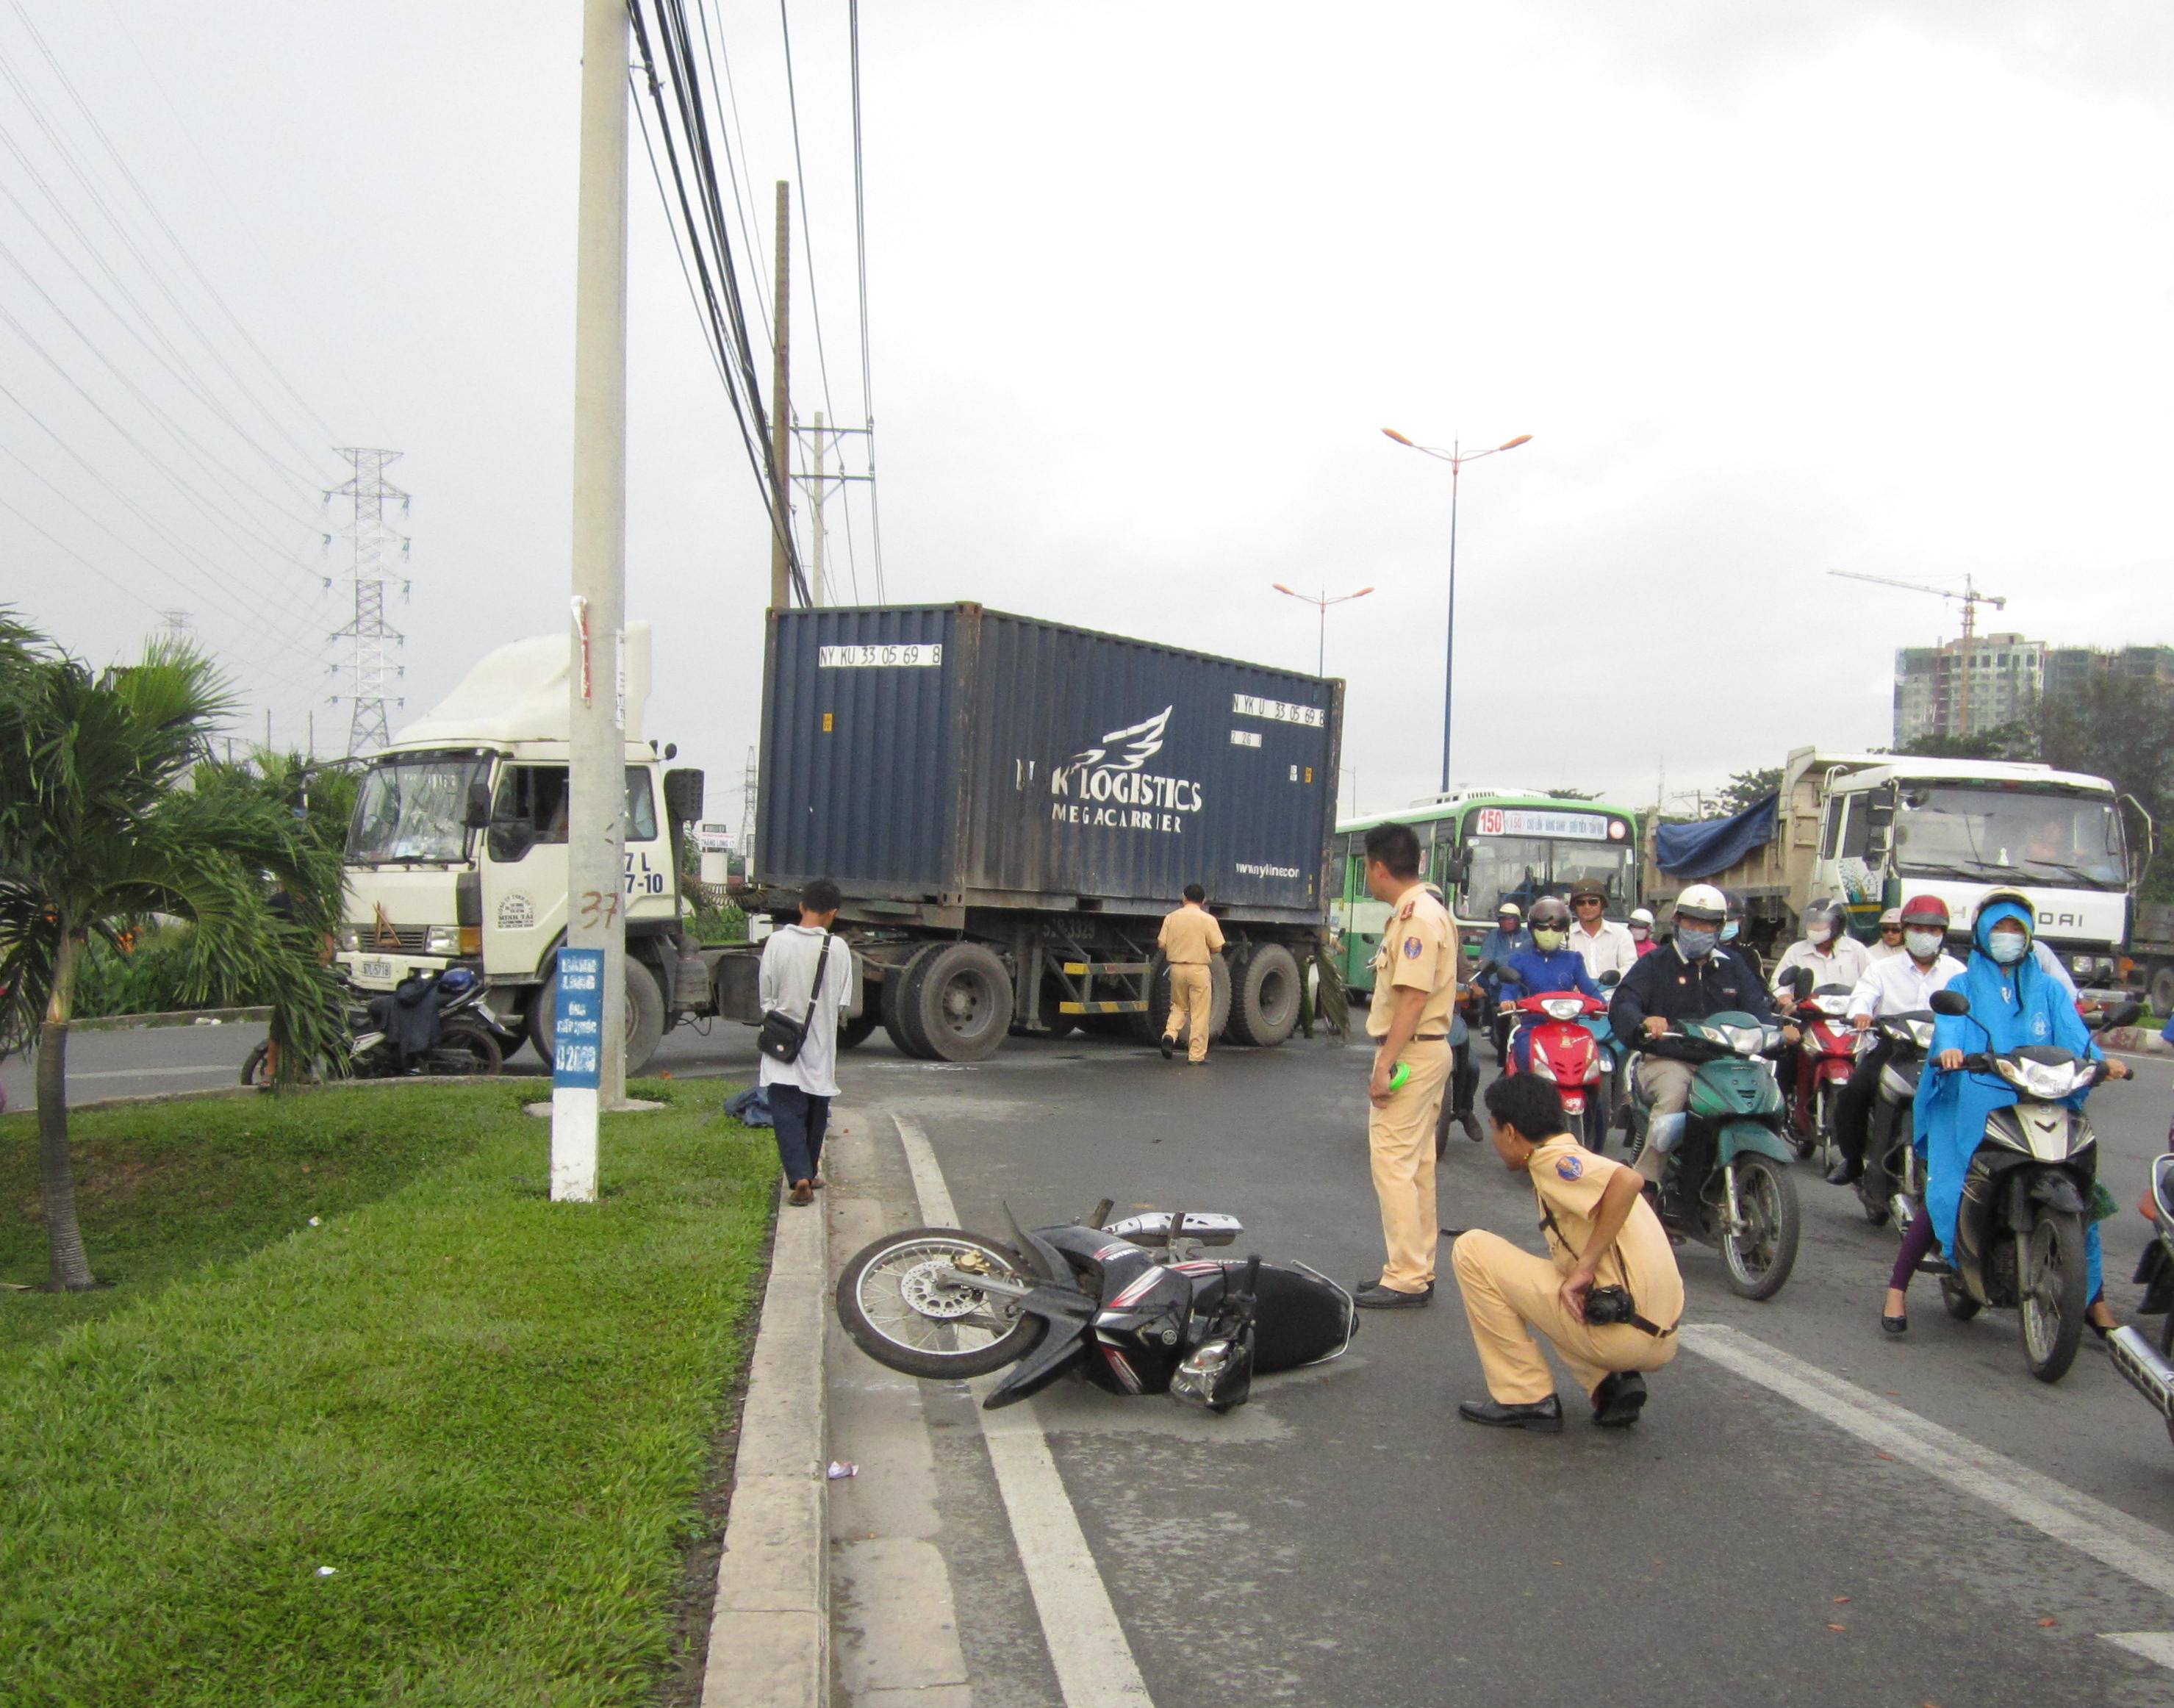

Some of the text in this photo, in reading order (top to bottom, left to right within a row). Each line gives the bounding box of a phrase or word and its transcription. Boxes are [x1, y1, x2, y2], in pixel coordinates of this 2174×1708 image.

[819, 645, 941, 666] NY KU 33 05 69 8
[1079, 767, 1202, 812] LOGISTICS
[1480, 810, 1502, 833] 150
[581, 890, 617, 929] 37
